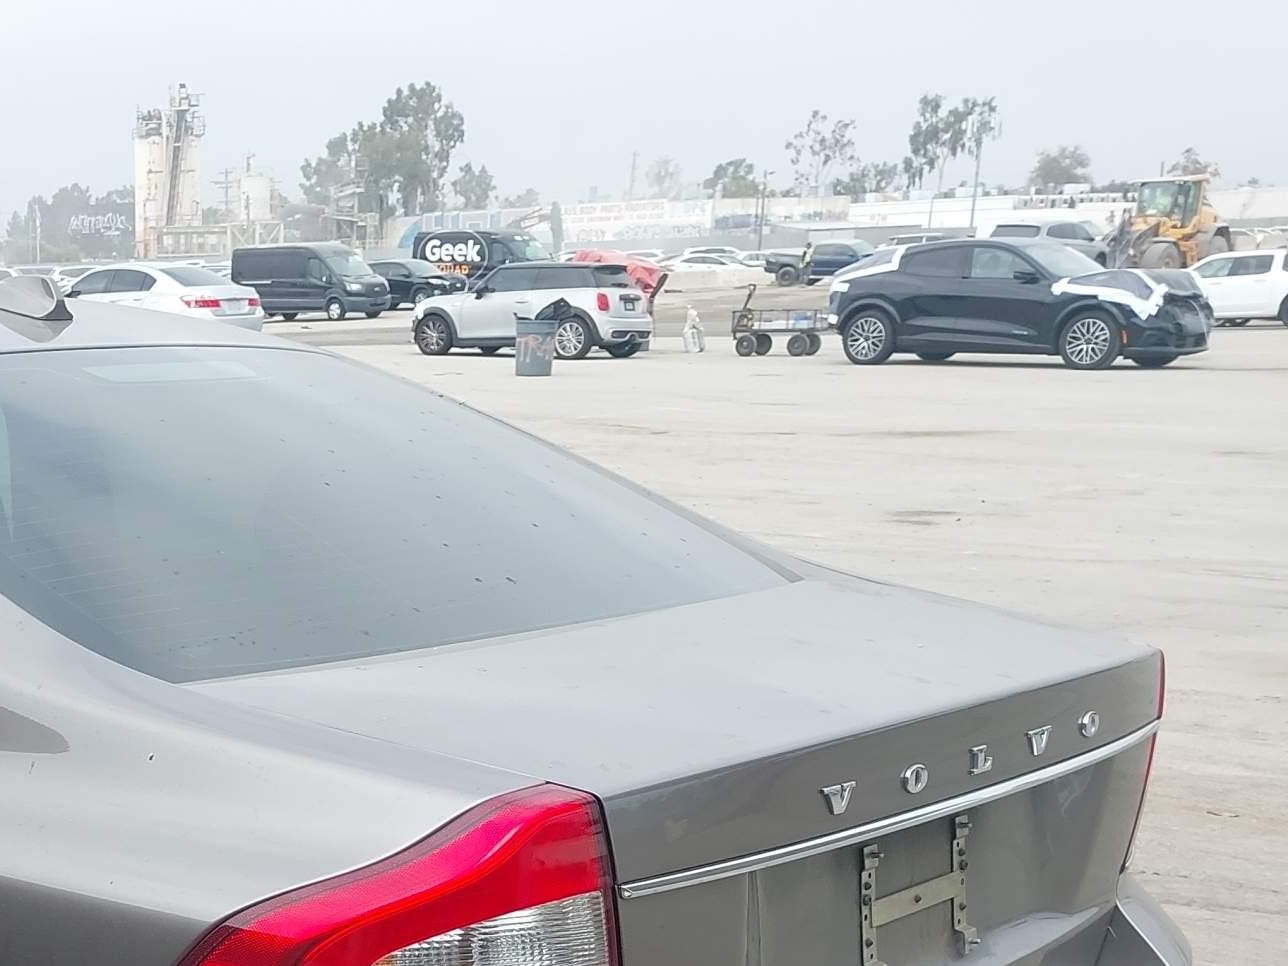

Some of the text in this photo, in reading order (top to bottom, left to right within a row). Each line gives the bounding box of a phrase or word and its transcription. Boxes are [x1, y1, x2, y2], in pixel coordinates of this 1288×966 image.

[425, 239, 481, 262] Geek
[438, 264, 470, 275] QUAD
[819, 711, 1101, 815] VOLVO
